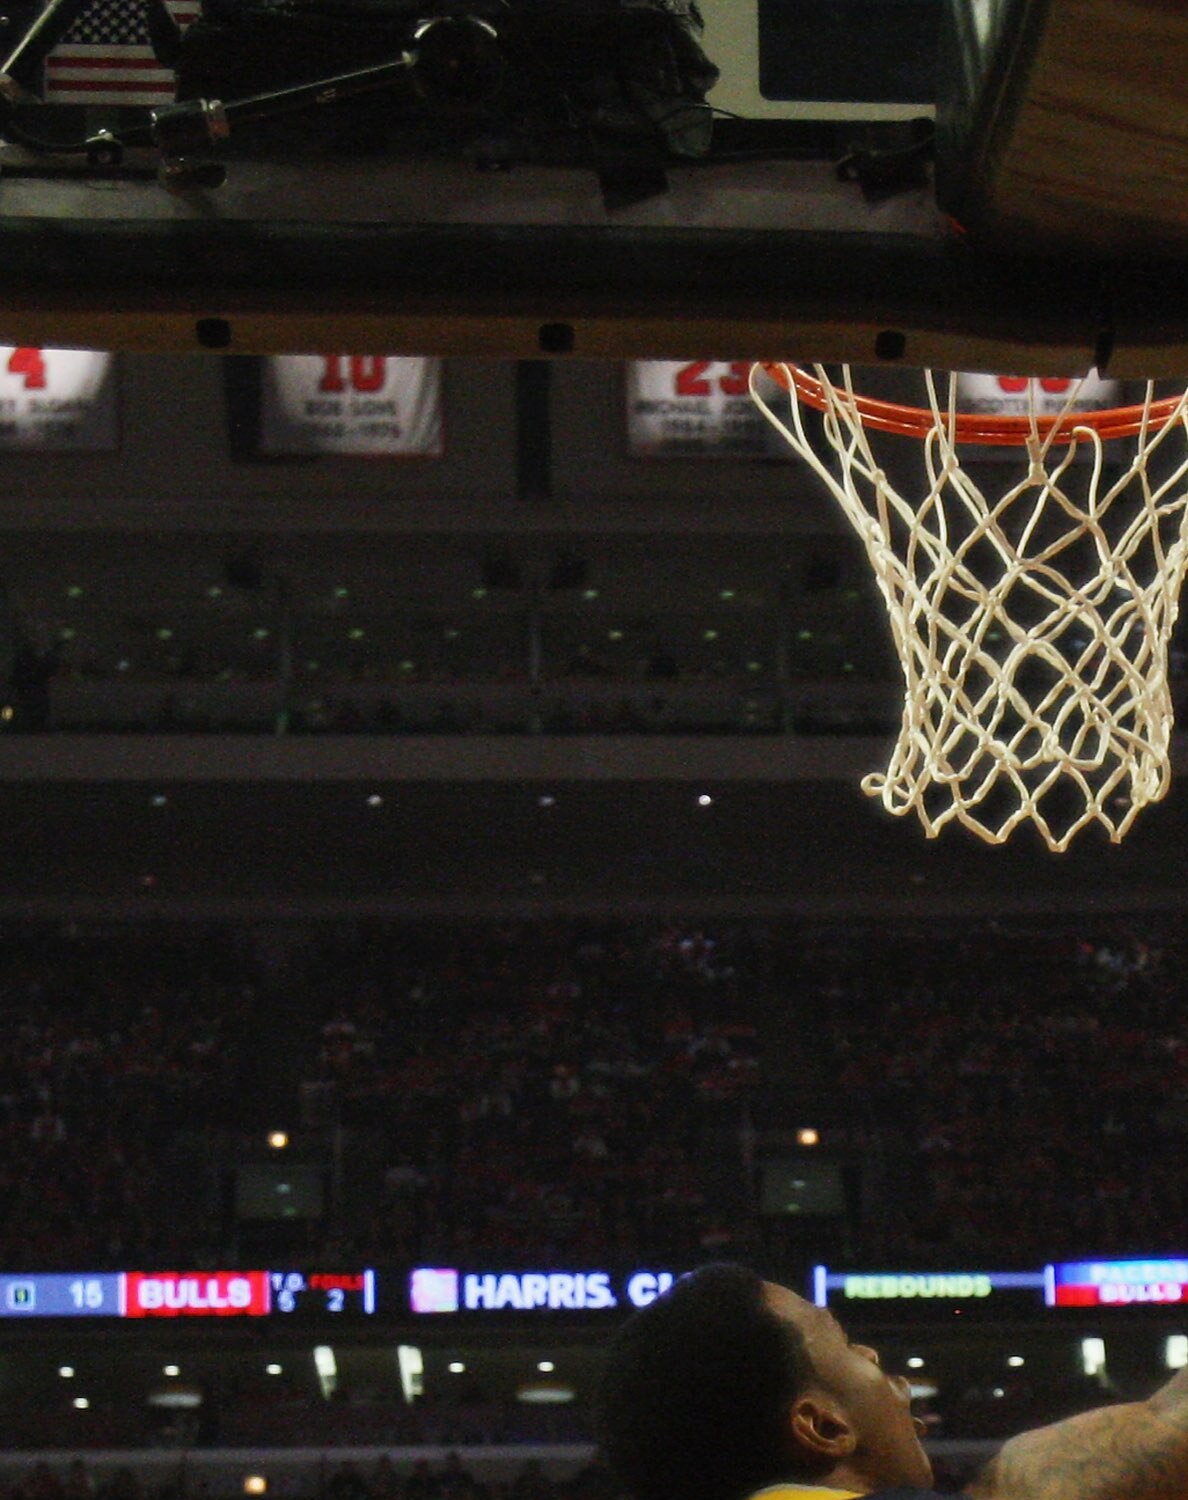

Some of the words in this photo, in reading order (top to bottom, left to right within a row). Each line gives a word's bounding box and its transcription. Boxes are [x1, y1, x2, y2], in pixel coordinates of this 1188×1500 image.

[138, 1279, 251, 1309] BULLS
[326, 1287, 345, 1312] 2
[844, 1275, 992, 1299] REBOUNDS
